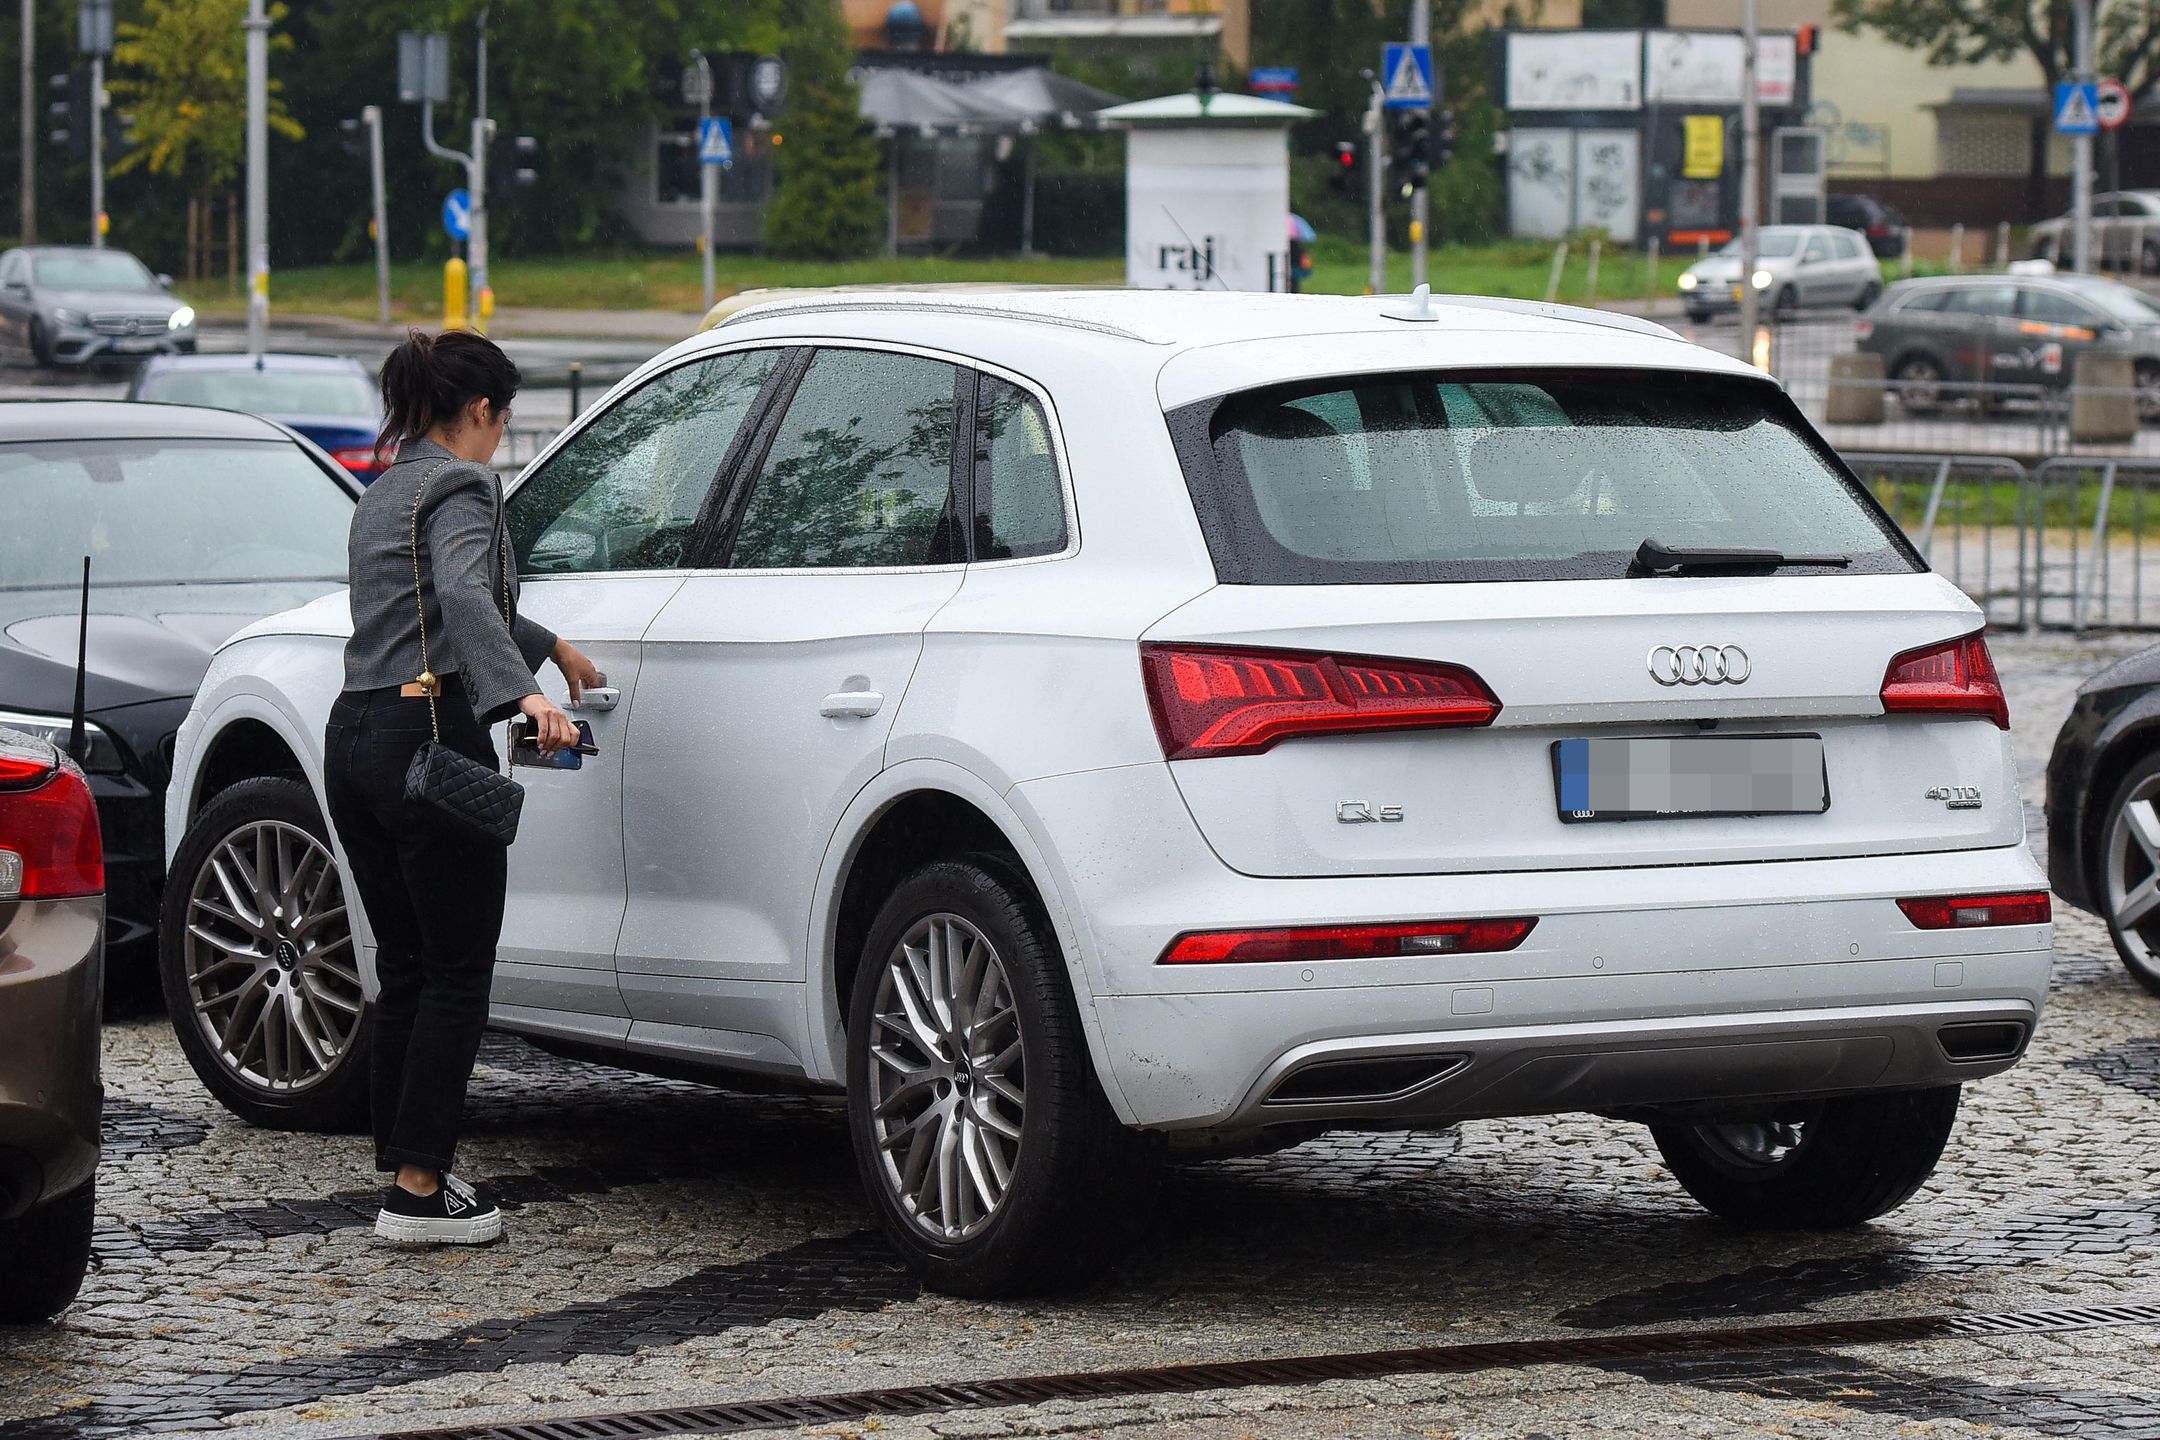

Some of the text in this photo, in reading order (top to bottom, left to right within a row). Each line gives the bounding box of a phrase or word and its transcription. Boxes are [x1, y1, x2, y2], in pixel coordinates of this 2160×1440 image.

[1925, 786, 1981, 800] 40 TDI
[1336, 799, 1404, 824] Q5
